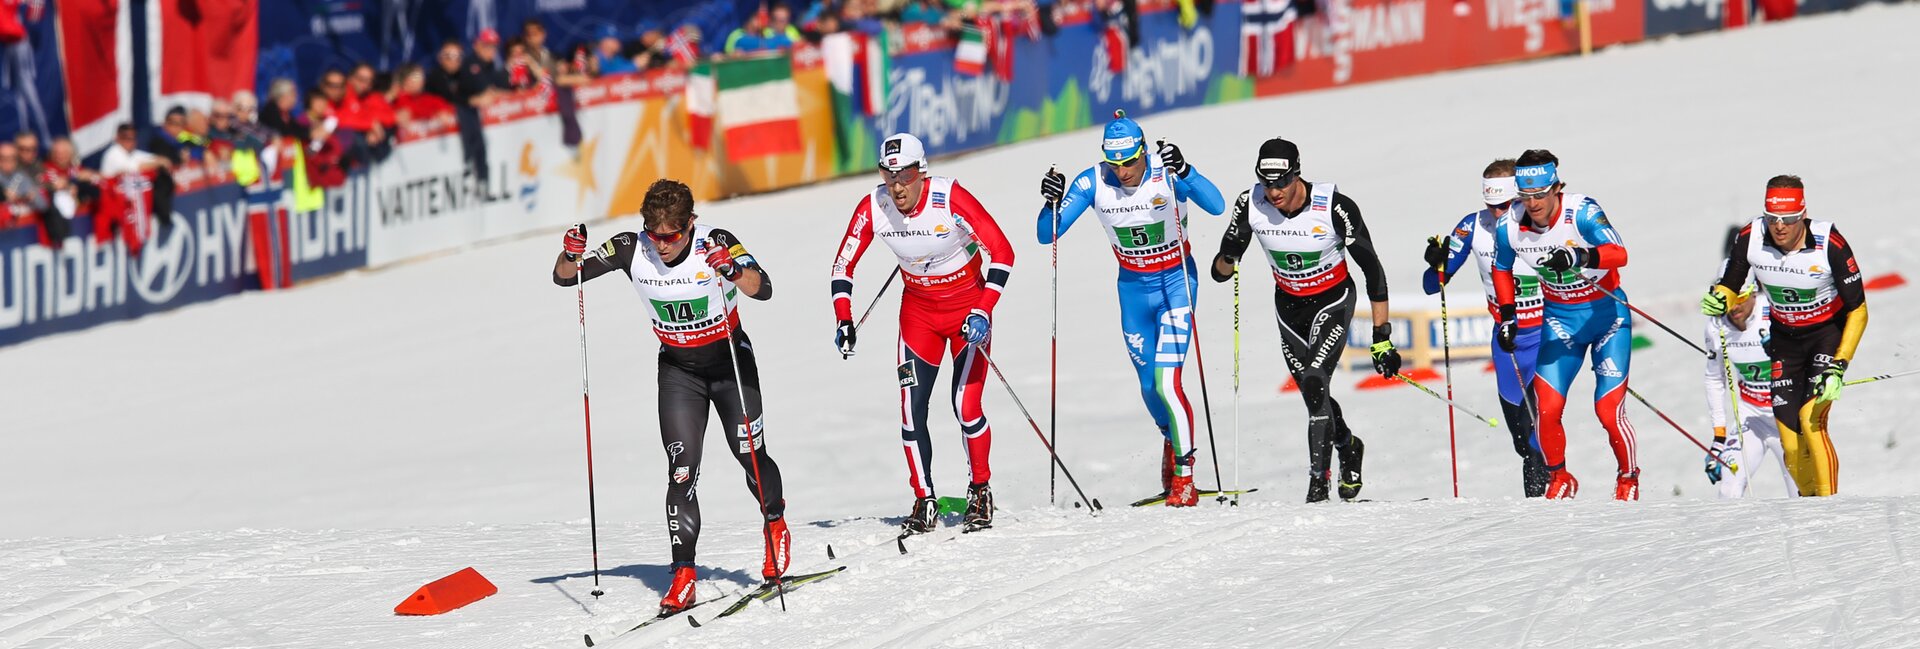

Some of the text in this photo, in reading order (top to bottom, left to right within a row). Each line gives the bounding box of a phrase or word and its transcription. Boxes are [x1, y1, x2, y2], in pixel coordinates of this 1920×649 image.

[1100, 204, 1150, 214] VATTENFALL
[1334, 203, 1355, 238] helvetia
[880, 229, 932, 238] VATTENFALL
[1131, 226, 1150, 246] 5
[1256, 228, 1309, 237] VATTENFALL
[1286, 253, 1304, 271] 9
[1755, 263, 1806, 275] VATTENFALL
[637, 277, 694, 288] VATTENFALL
[1782, 288, 1800, 303] 3
[661, 302, 696, 323] 14
[1155, 306, 1192, 363] ITA
[1310, 324, 1345, 369] RAIFFEISEN
[668, 504, 683, 546] USA
